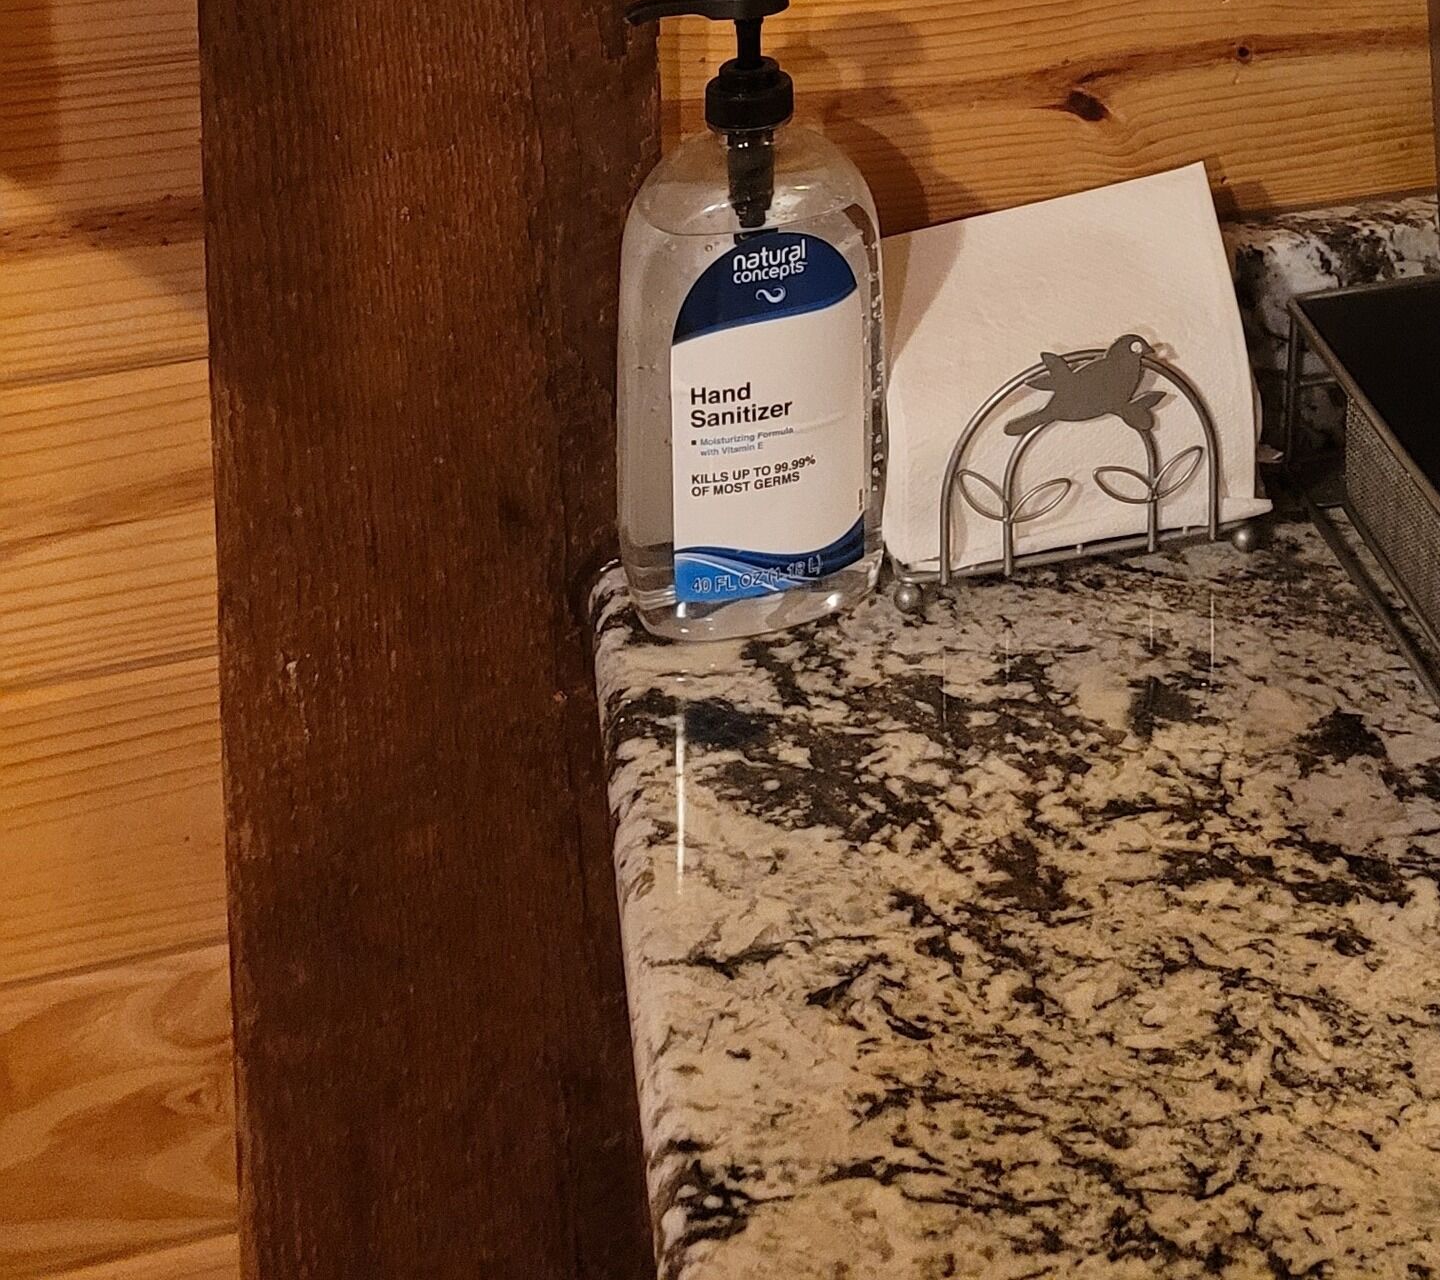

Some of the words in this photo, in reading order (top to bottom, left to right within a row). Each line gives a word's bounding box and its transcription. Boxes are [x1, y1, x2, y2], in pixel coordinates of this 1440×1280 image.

[733, 238, 806, 272] natural
[733, 260, 808, 284] concepts
[690, 382, 751, 406] Hand
[690, 400, 793, 428] Sanitizer
[700, 433, 755, 446] Moisturizing
[757, 426, 795, 440] Formula
[700, 448, 720, 456] with
[722, 443, 756, 456] Vitamin
[758, 442, 764, 450] E
[691, 470, 730, 485] KILLS
[732, 468, 750, 481] UP
[753, 465, 772, 478] TO
[774, 454, 817, 474] 99.99%
[691, 486, 710, 498] OF
[713, 480, 750, 496] MOST
[753, 471, 800, 490] GERMS
[691, 576, 713, 594] 40
[714, 574, 737, 593] FL
[739, 572, 763, 589] OZ
